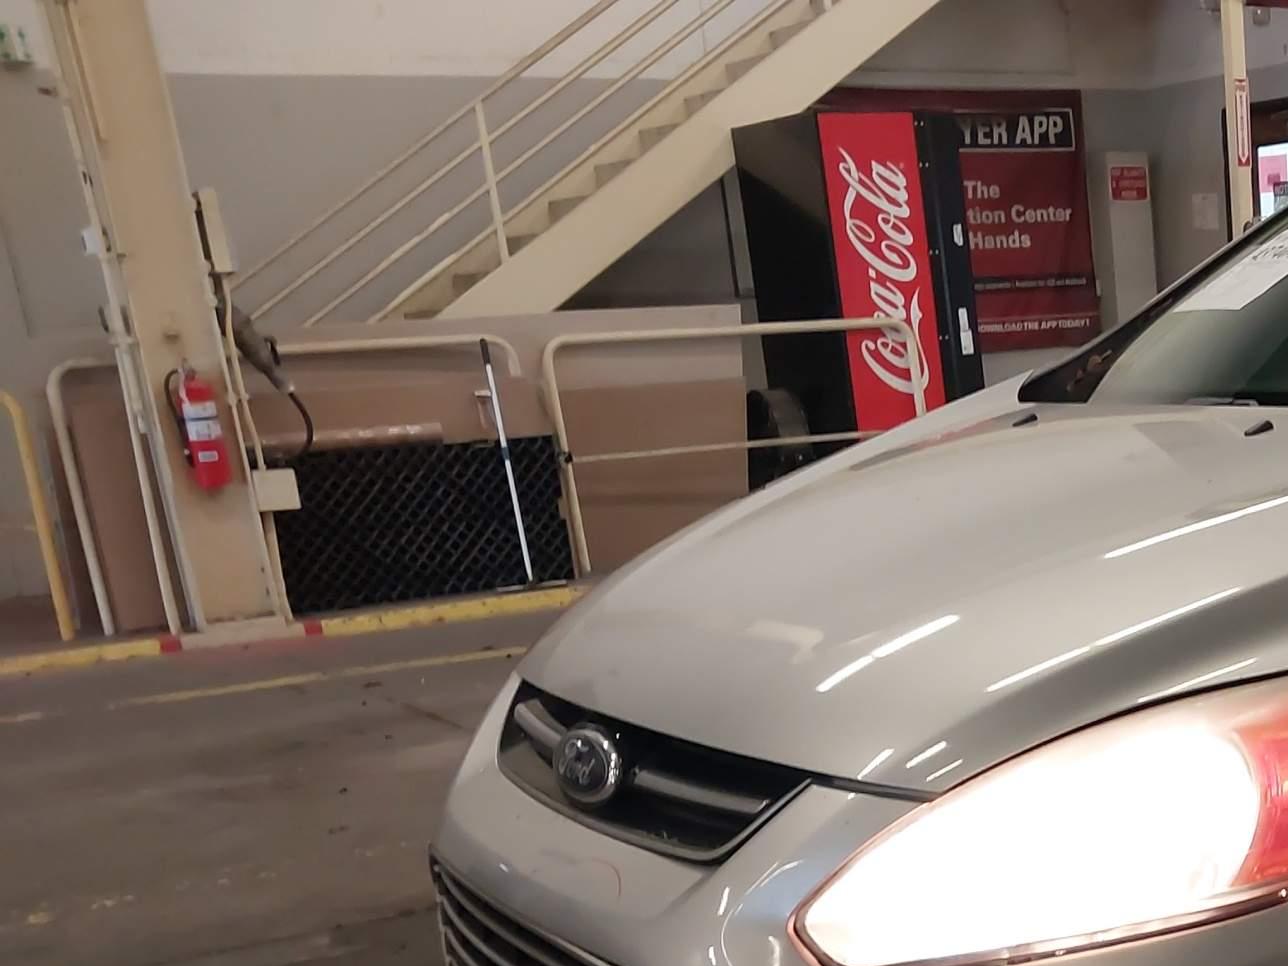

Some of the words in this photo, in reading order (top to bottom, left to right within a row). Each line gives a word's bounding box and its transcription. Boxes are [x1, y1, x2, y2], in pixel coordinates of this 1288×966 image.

[1015, 115, 1064, 145] APP
[963, 180, 1000, 199] The
[1011, 204, 1072, 223] Center
[968, 229, 1032, 249] Hands
[1040, 320, 1058, 330] APP
